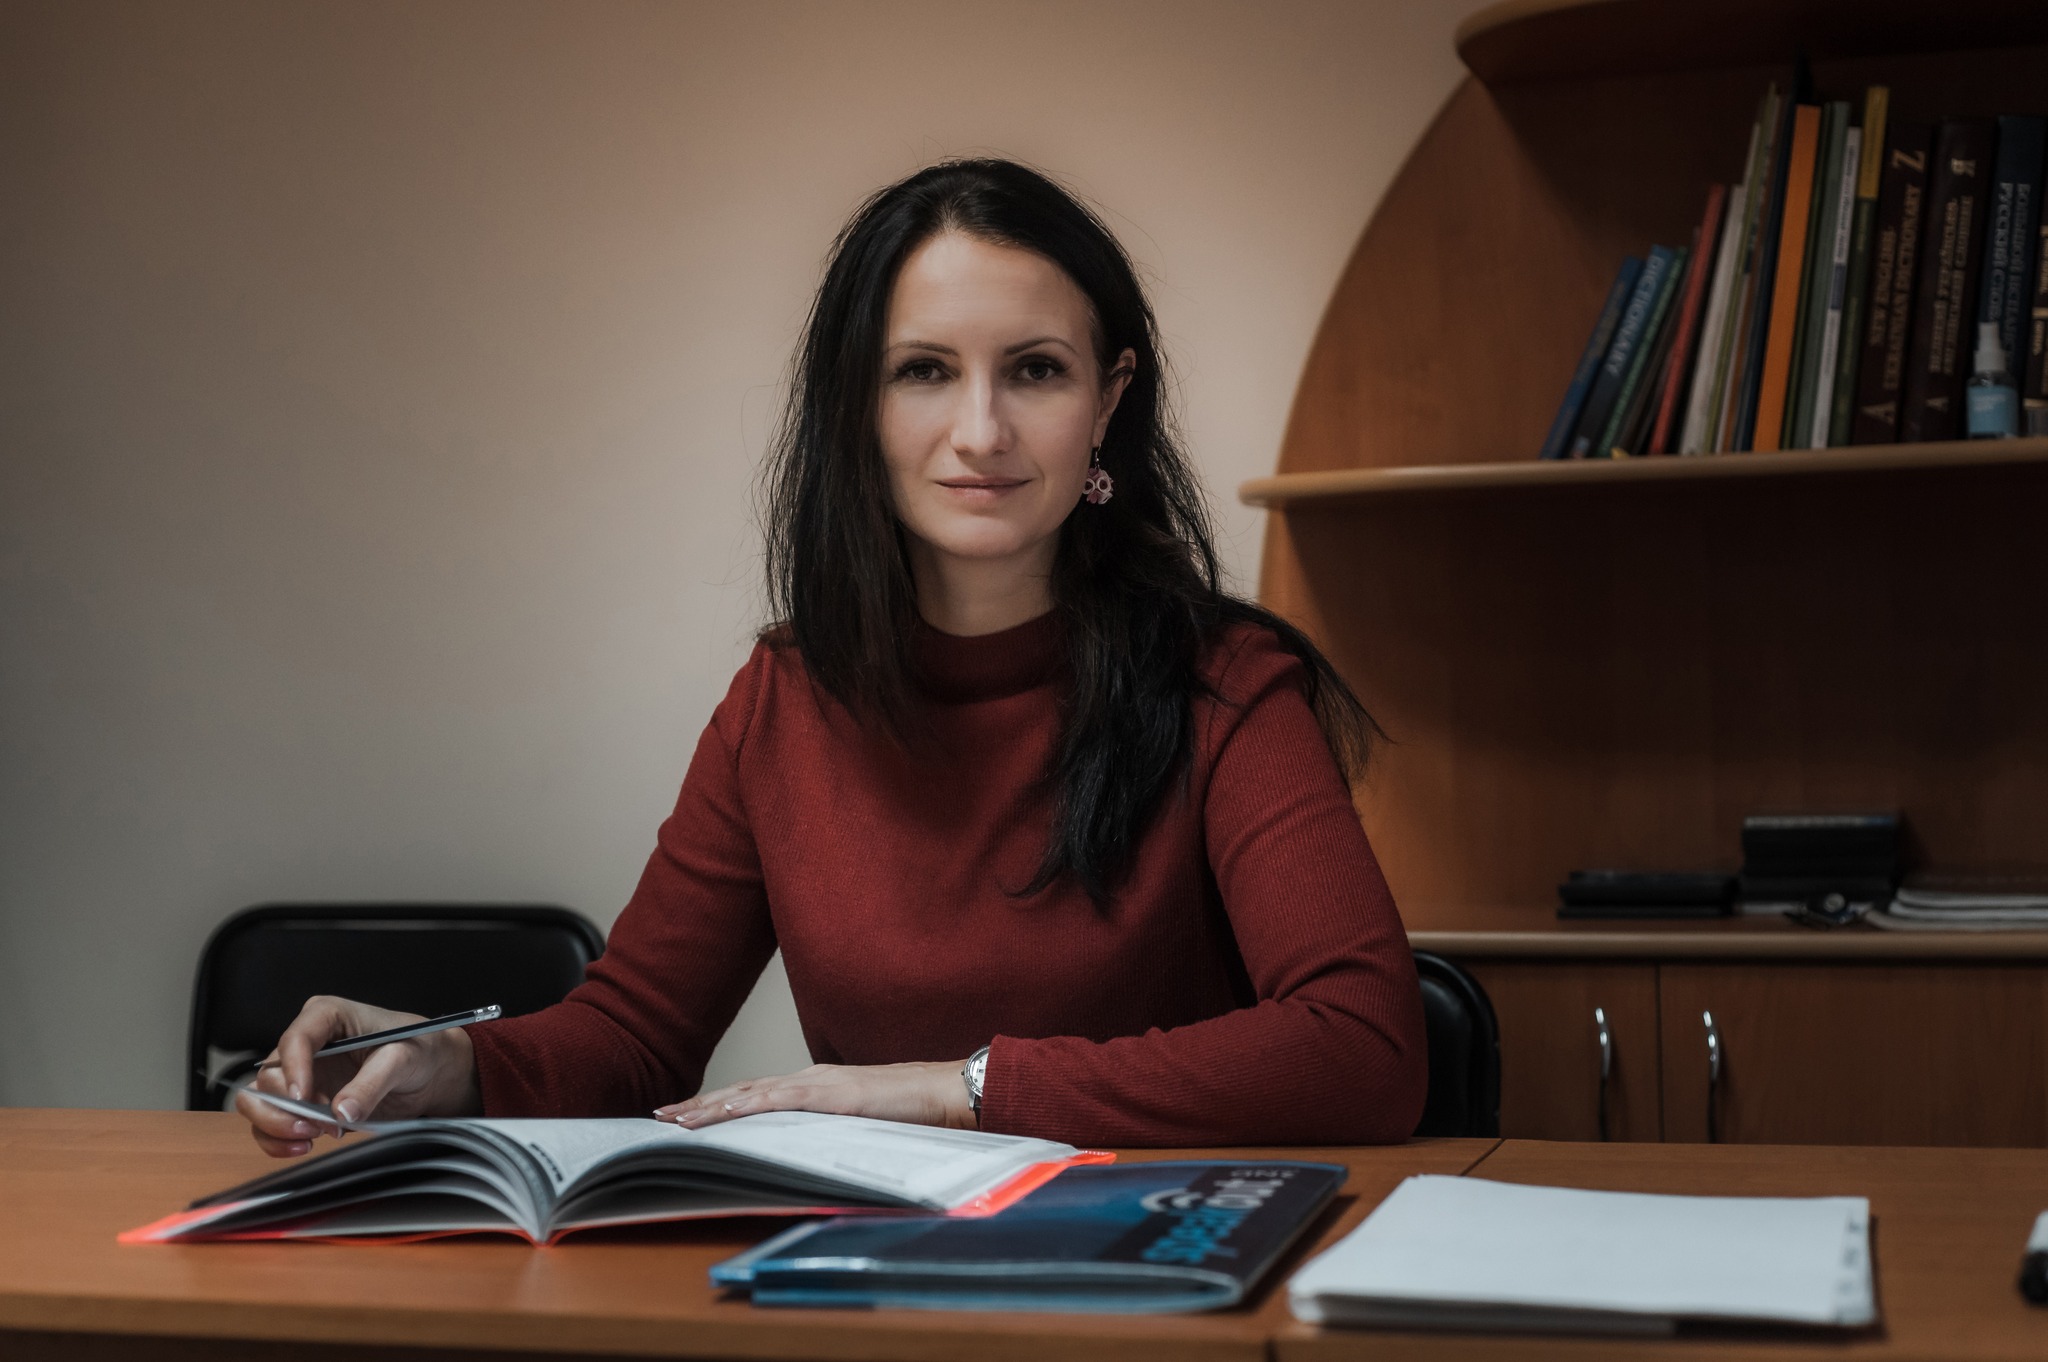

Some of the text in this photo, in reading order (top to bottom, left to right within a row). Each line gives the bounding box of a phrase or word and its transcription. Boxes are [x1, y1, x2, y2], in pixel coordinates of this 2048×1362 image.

[1891, 149, 1926, 173] Z
[1951, 158, 1977, 178] Я
[1894, 183, 1921, 293] DICTIONARY
[1992, 183, 2013, 269] РУССКИЙ
[1605, 254, 1665, 377] DICTIONARY
[1868, 305, 1888, 346] NEW
[1860, 402, 1897, 425] A
